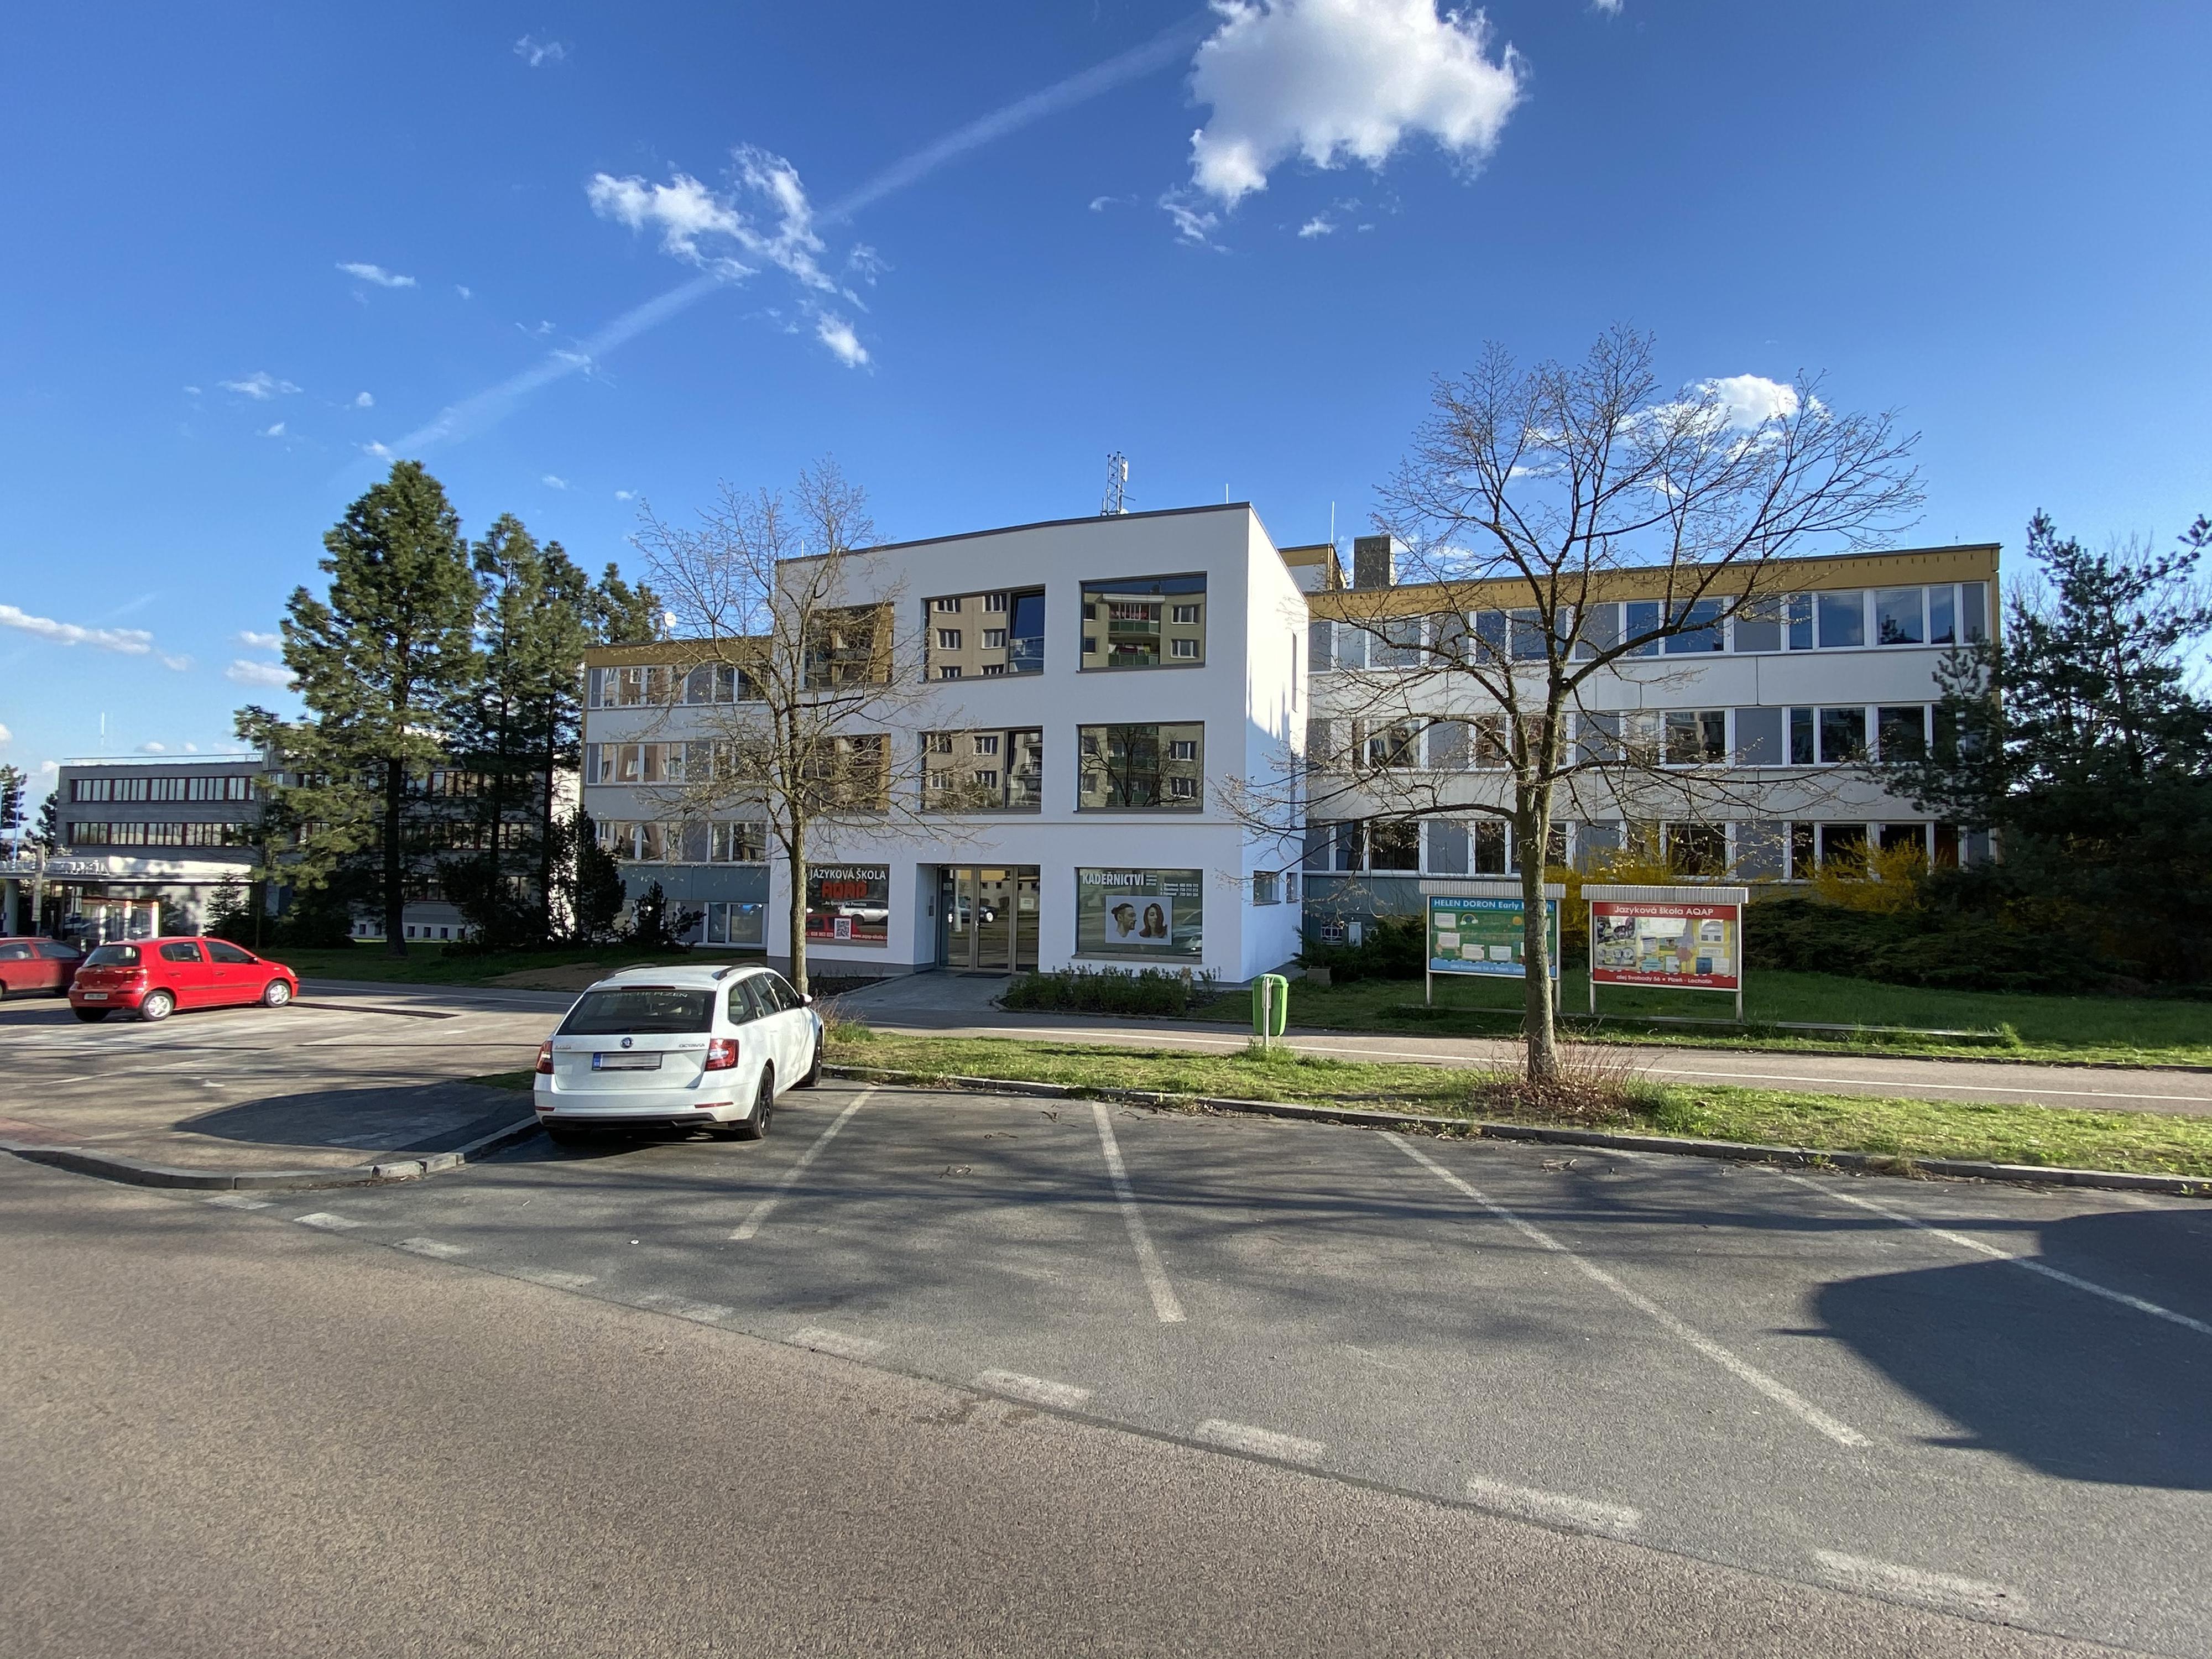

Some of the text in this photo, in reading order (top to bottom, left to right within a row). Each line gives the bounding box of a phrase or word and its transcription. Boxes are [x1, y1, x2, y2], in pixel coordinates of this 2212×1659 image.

[809, 868, 886, 880] JAZYKOVÁ ŠKOLA
[1082, 872, 1144, 886] KADEŘNICTVÍ
[1434, 899, 1461, 907] HELEN
[1498, 901, 1520, 911] Early
[1614, 905, 1714, 916] Jazyková škola AQAP
